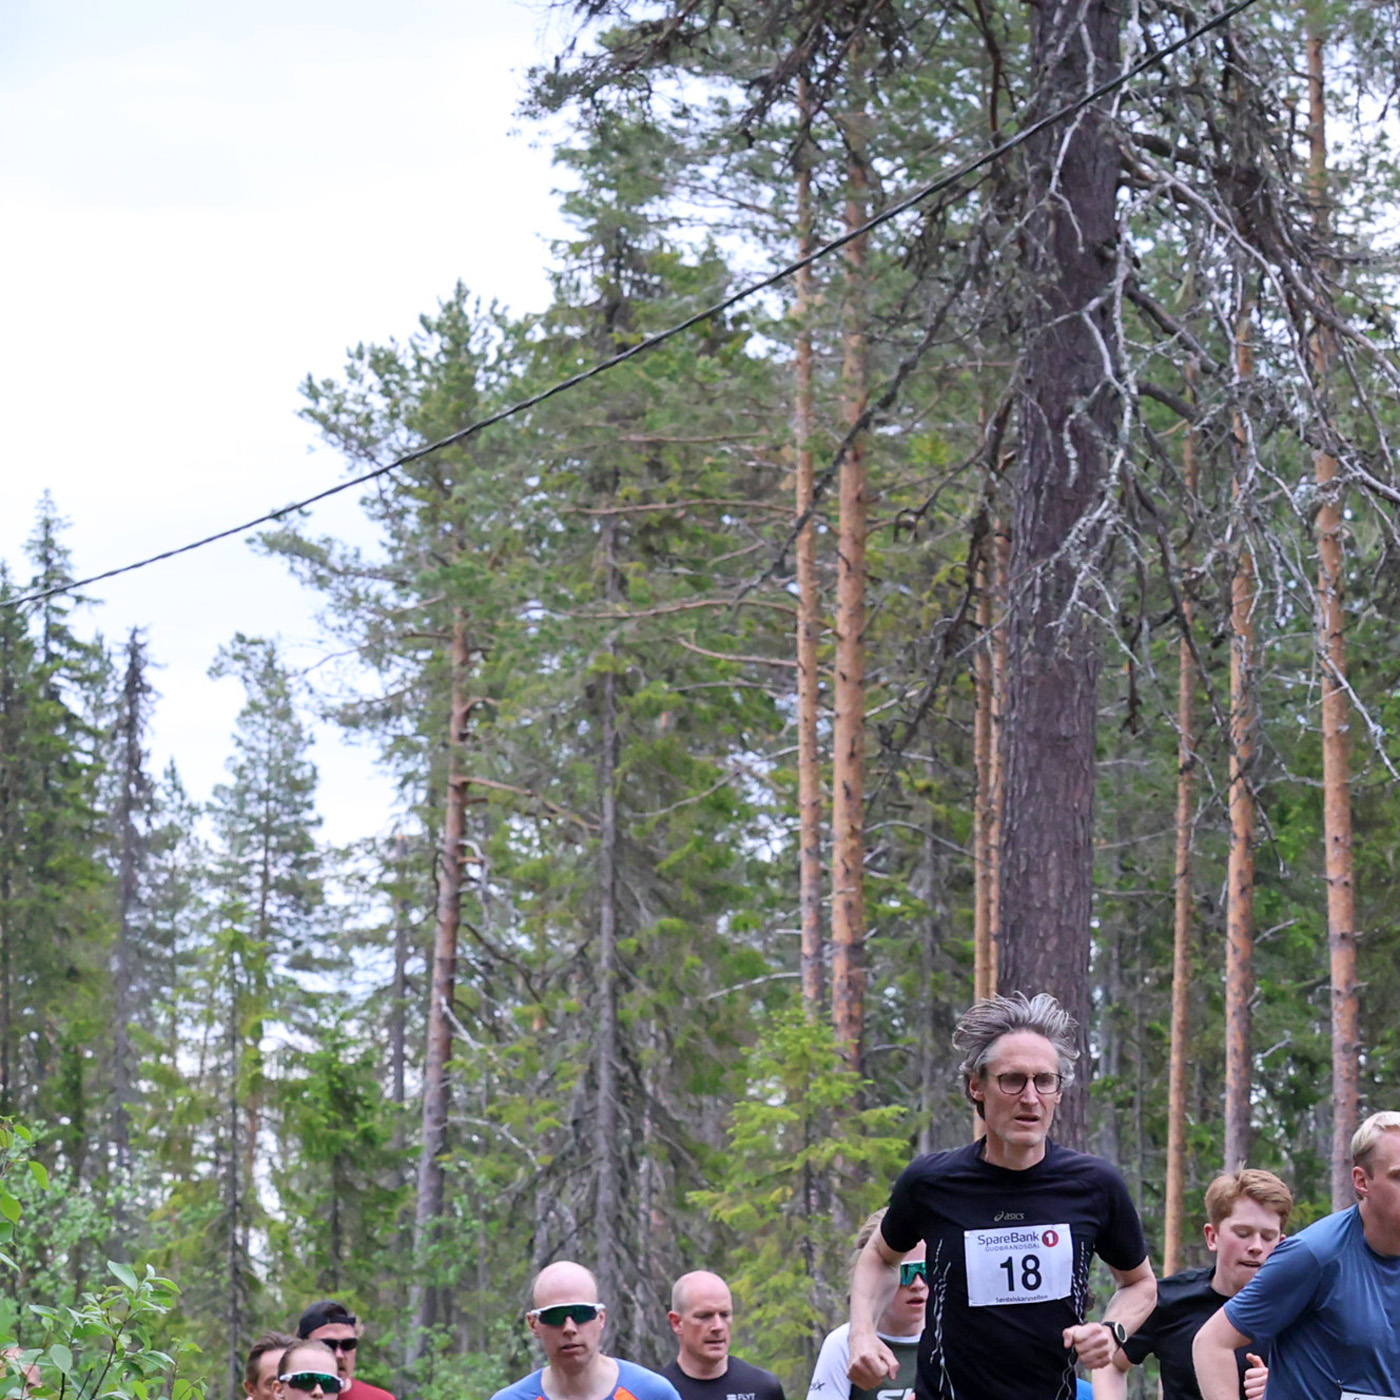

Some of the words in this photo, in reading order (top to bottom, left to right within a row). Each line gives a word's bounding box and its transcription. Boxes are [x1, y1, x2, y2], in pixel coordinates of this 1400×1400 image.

[977, 1231, 1040, 1246] SpareBank
[984, 1243, 1041, 1253] GUDBRANDSDAL
[999, 1254, 1042, 1292] 18
[736, 1393, 756, 1400] FLYT
